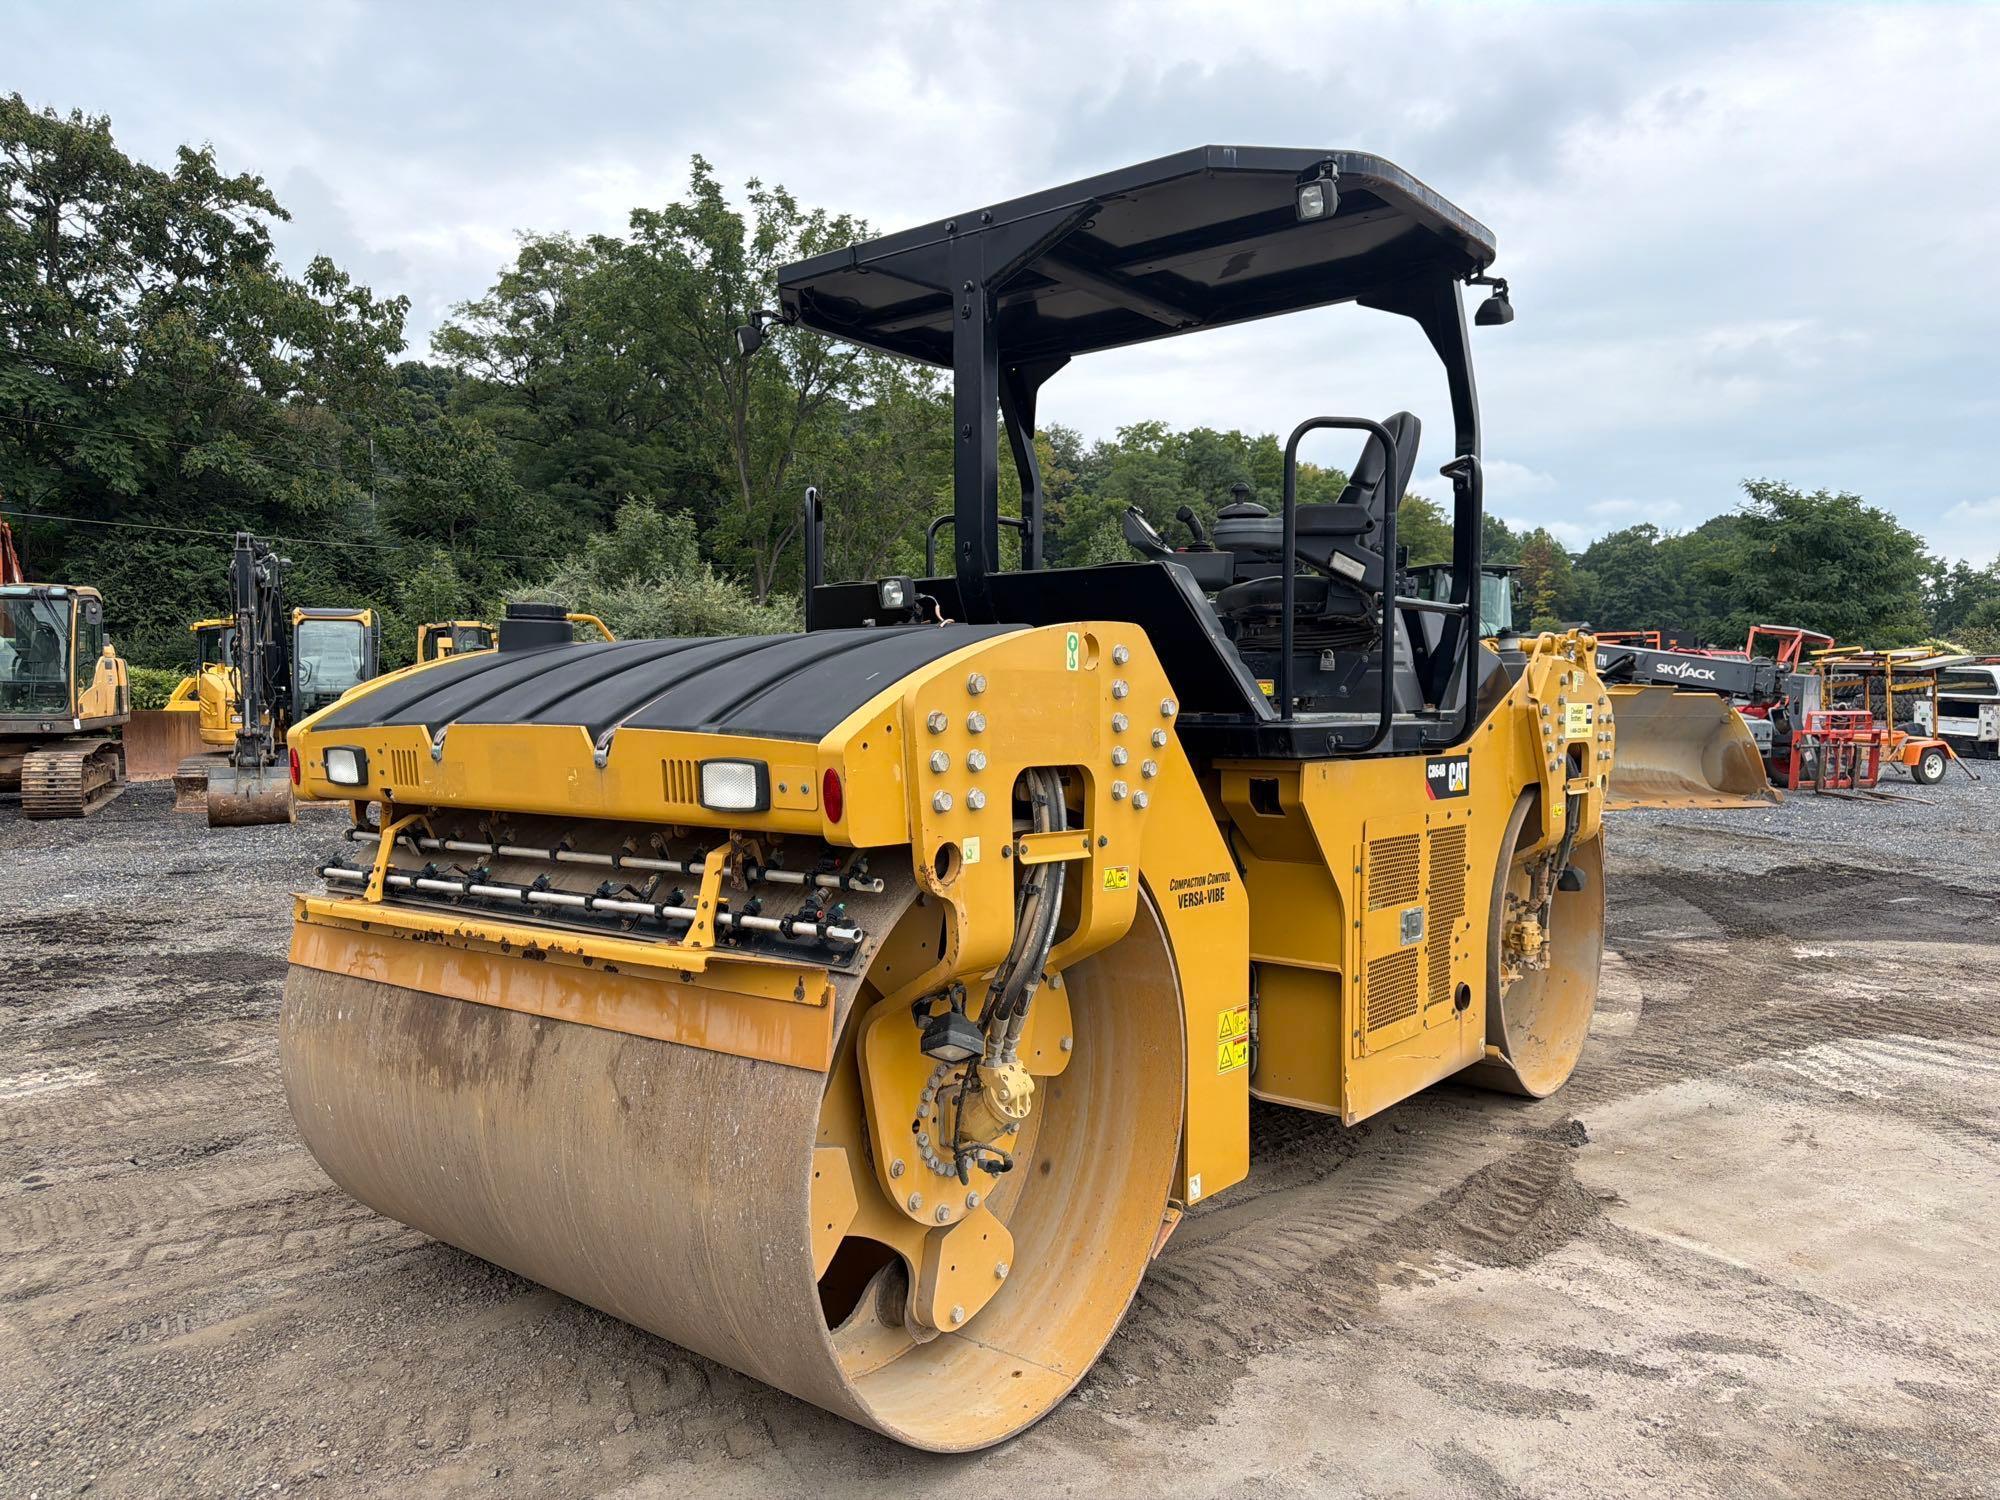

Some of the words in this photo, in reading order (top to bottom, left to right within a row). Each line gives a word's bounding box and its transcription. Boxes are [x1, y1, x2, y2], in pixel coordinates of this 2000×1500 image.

[1656, 661, 1716, 681] SKYJACK
[1449, 762, 1468, 792] CAT
[1178, 887, 1225, 909] VERSA-VIBE
